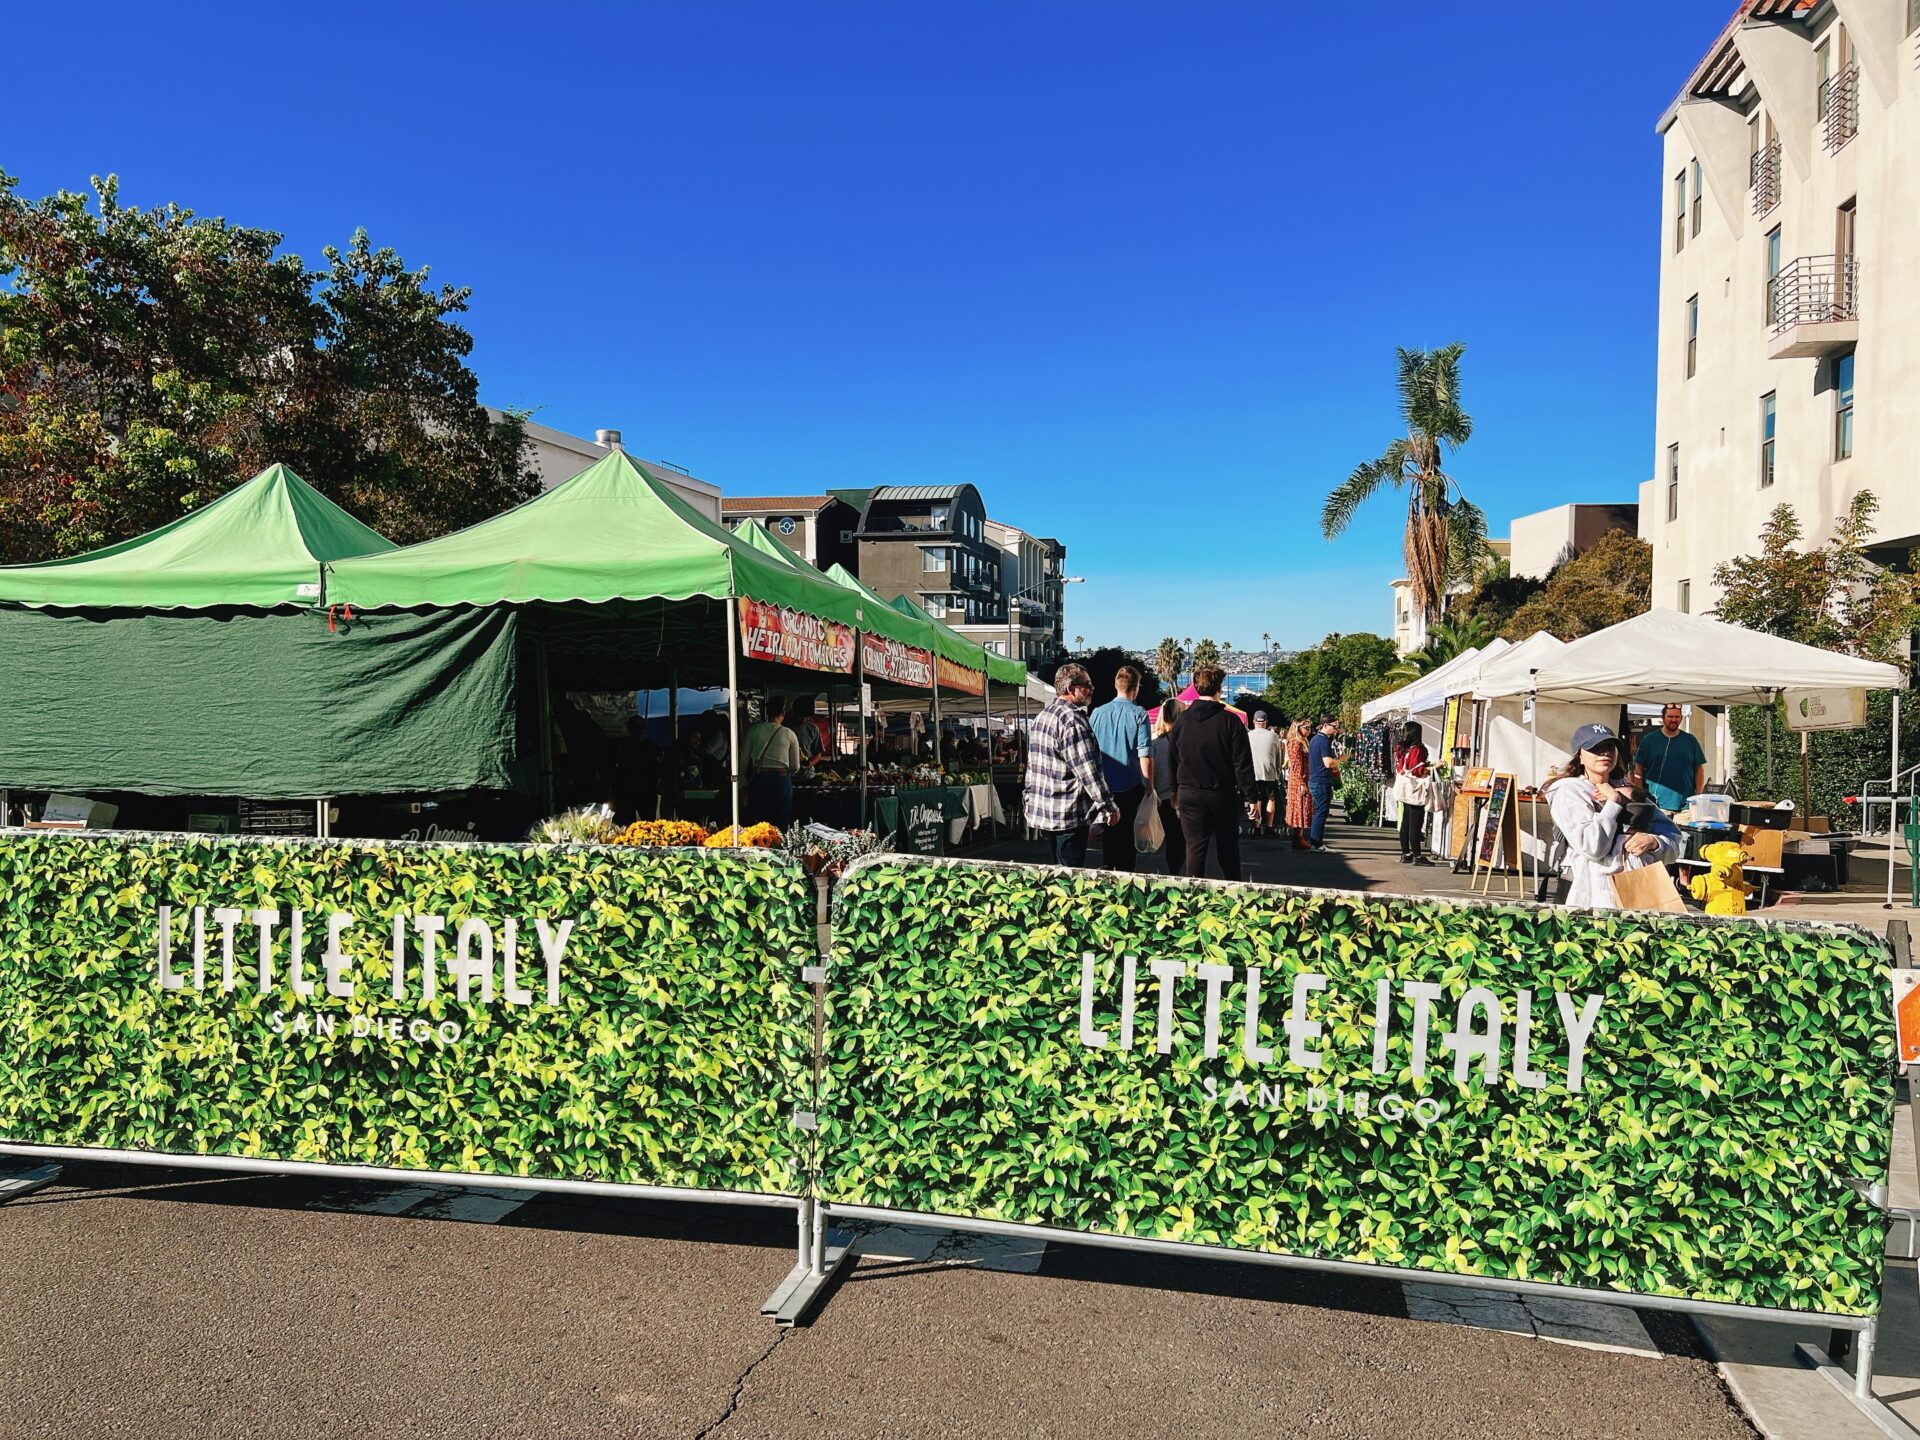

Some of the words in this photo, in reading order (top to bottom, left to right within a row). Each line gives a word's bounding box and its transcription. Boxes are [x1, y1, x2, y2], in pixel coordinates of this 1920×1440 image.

[781, 609, 825, 641] ORGANIC
[748, 627, 801, 660] HEIRLOOM
[1592, 724, 1608, 733] NY
[158, 905, 353, 997] LITTLE
[392, 914, 574, 1006] ITALY
[271, 1010, 334, 1037] SAN
[354, 1017, 461, 1044] DIEGO
[1079, 952, 1327, 1069] LITTLE
[1372, 978, 1604, 1092] ITALY
[1202, 1077, 1281, 1109] SAN
[1307, 1087, 1442, 1124] DIEGO
